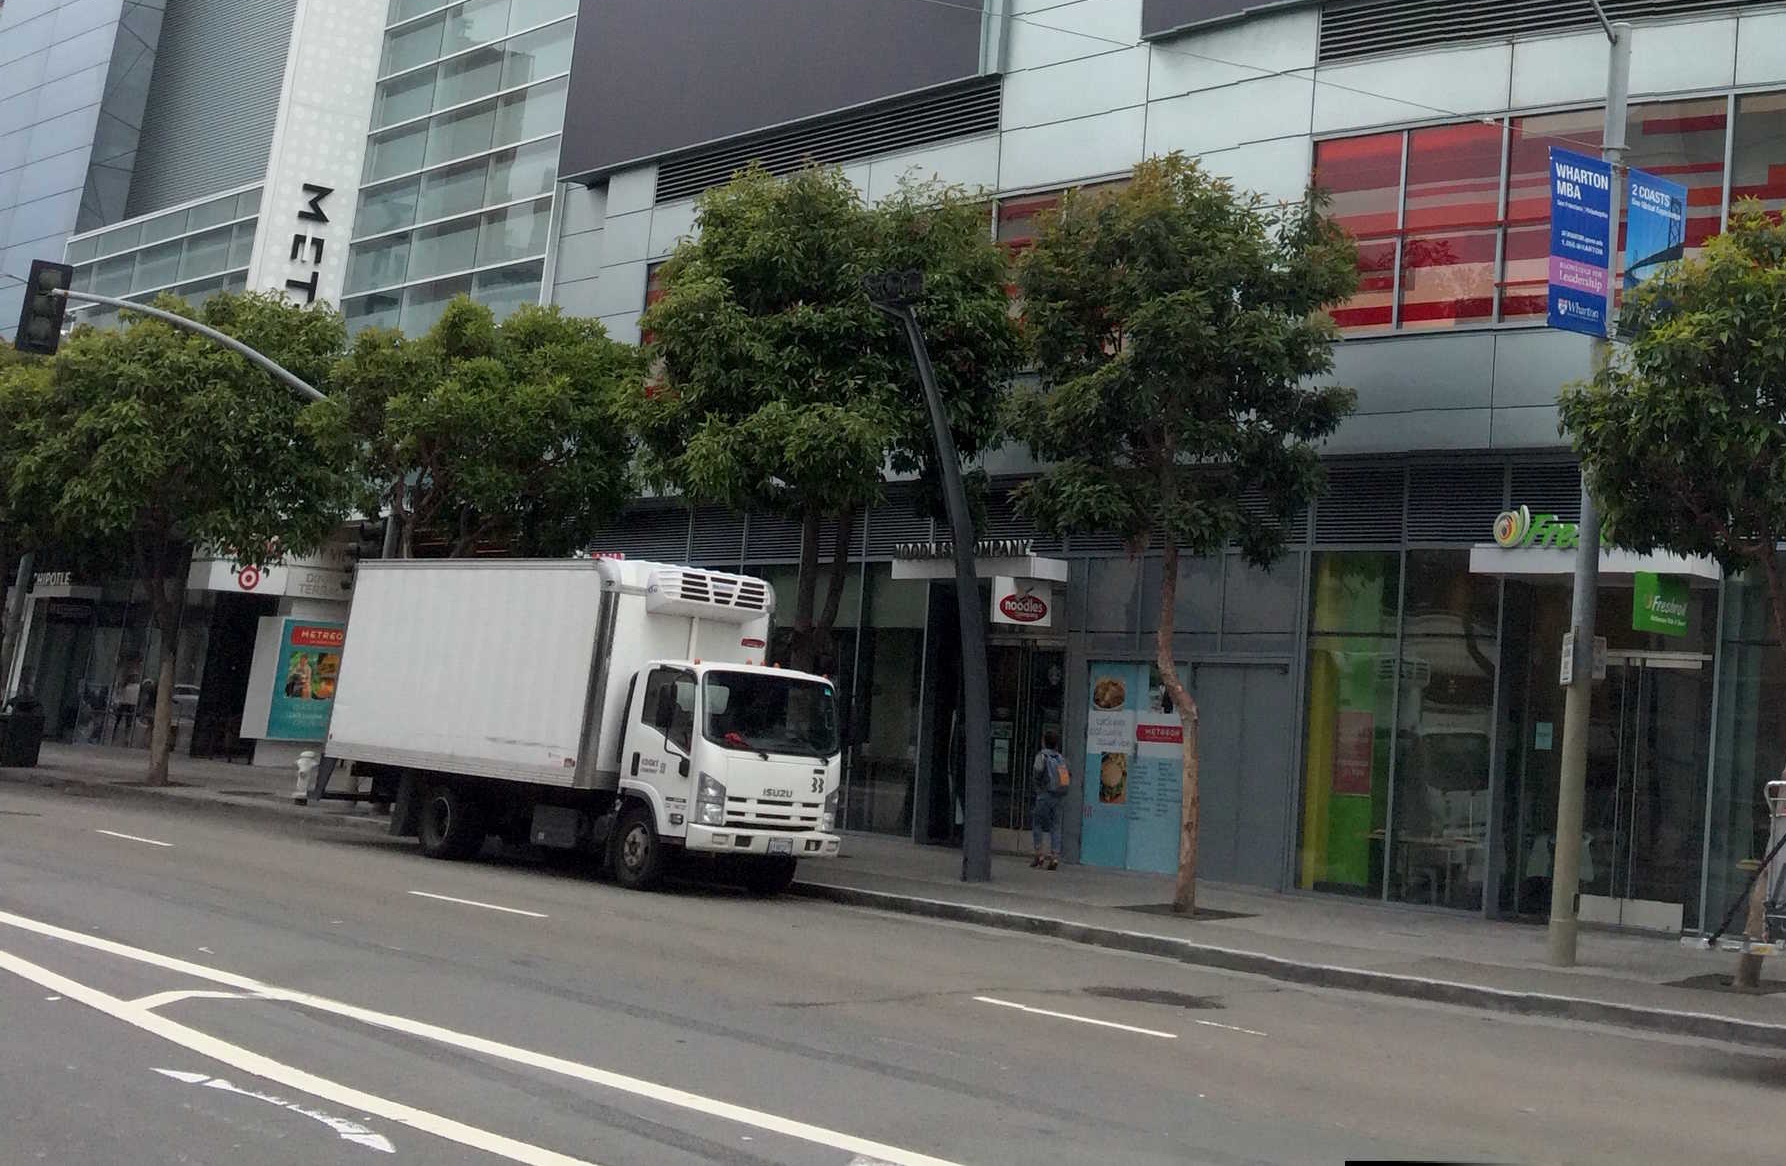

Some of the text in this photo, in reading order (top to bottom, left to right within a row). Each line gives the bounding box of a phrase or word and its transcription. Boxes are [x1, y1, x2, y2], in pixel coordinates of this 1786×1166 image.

[1555, 162, 1609, 190] WHARTON
[1557, 179, 1582, 200] MBA
[1632, 183, 1671, 208] 2 COASTS
[285, 183, 335, 307] MET
[1559, 269, 1603, 293] Leadership
[1524, 514, 1579, 547] Fre
[973, 539, 1028, 556] OMPANY
[1004, 598, 1044, 614] noodles
[762, 788, 793, 798] ISUZU
